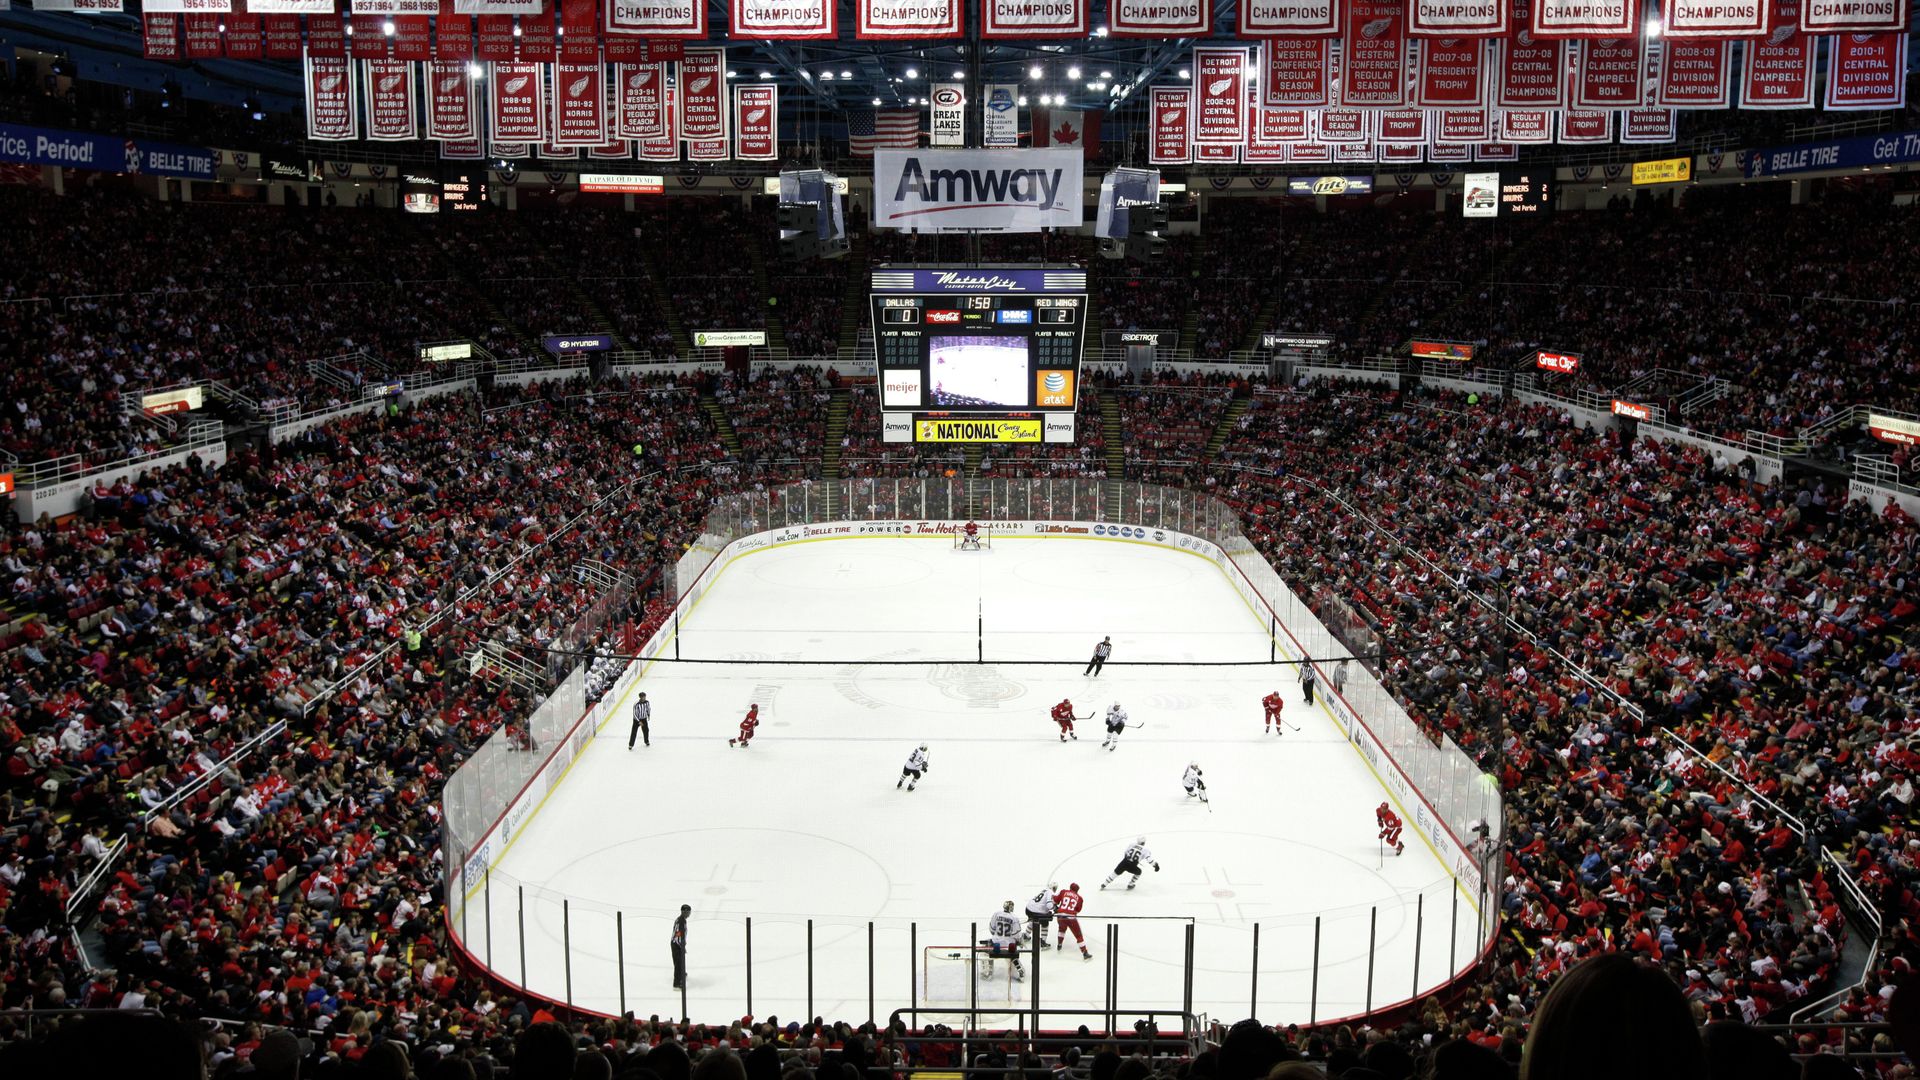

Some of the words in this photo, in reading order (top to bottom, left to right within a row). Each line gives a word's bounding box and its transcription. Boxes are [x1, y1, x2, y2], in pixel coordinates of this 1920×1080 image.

[355, 0, 393, 10] 1957-1964
[1814, 3, 1893, 16] CHAMPIONS
[616, 7, 691, 20] CHAMPIONS
[745, 8, 822, 20] CHAMPIONS
[873, 6, 948, 19] CHAMPIONS
[998, 4, 1073, 17] CHAMPIONS
[1123, 6, 1197, 18] CHAMPIONS
[1253, 7, 1328, 18] CHAMPIONS
[1353, 7, 1371, 16] RED
[1374, 7, 1401, 15] WINGS
[1420, 5, 1495, 18] CHAMPIONS
[1546, 7, 1622, 18] CHAMPIONS
[1677, 7, 1755, 19] CHAMPIONS
[1278, 41, 1317, 49] 2006-07
[1356, 41, 1395, 49] 2007-08
[1278, 51, 1317, 59] WESTERN
[1356, 51, 1395, 60] WESTERN
[1513, 50, 1552, 58] 2007-08
[1592, 49, 1633, 57] 2007-08
[1675, 48, 1715, 57] 2008-09
[1760, 47, 1800, 56] 2008-09
[1850, 47, 1884, 56] 2010-11
[1433, 54, 1472, 62] 2007-08
[1272, 61, 1322, 69] CONFERENCE
[1351, 61, 1399, 69] CONFERENCE
[1512, 63, 1552, 71] CENTRAL
[1588, 62, 1636, 70] CLARENCE
[1674, 60, 1715, 70] CENTRAL
[1755, 60, 1804, 69] CLARENCE
[1844, 59, 1888, 69] CENTRAL
[1278, 71, 1316, 80] REGULAR
[1355, 72, 1393, 80] REGULAR
[1511, 75, 1552, 84] DIVISION
[1587, 75, 1636, 83] CAMPBELL
[1672, 73, 1715, 82] DIVISION
[1754, 73, 1802, 82] CAMPBELL
[1843, 72, 1889, 82] DIVISION
[1280, 82, 1314, 90] SEASON
[1357, 82, 1391, 90] SEASON
[1435, 81, 1468, 89] TROPHY
[1764, 85, 1789, 94] BOWL
[1506, 88, 1557, 96] CHAMPIONS
[1598, 88, 1623, 96] BOWL
[1668, 85, 1719, 95] CHAMPIONS
[1838, 85, 1893, 95] CHAMPIONS
[1272, 92, 1321, 101] CHAMPIONS
[1349, 92, 1398, 101] CHAMPIONS
[1205, 98, 1235, 106] 2002-03
[934, 110, 961, 119] GREAT
[564, 119, 596, 127] DIVISION
[934, 120, 961, 129] LAKES
[685, 125, 720, 133] CHAMPIONS
[1200, 127, 1239, 135] CHAMPIONS
[561, 130, 600, 138] CHAMPIONS
[36, 136, 93, 162] Period!
[1873, 137, 1899, 160] Get
[149, 151, 185, 171] BELLE
[187, 155, 210, 173] TIRE
[1772, 151, 1812, 170] BELLE
[1812, 146, 1840, 164] TIRE
[894, 157, 1064, 210] Amway
[1503, 185, 1529, 193] RANGERS
[1542, 184, 1548, 192] 2
[1503, 194, 1524, 202] BRUINS
[886, 299, 915, 307] DALLAS
[968, 297, 991, 309] 1:58
[1055, 299, 1078, 307] WINGS
[902, 310, 911, 321] 0
[933, 311, 960, 321] Coca-Cola
[1002, 310, 1028, 319] DMC
[1057, 310, 1066, 321] 2
[571, 340, 599, 348] HYUNDAI
[1539, 353, 1558, 367] Great
[886, 382, 918, 394] meijer
[1043, 395, 1066, 405] at&t
[885, 423, 911, 432] Amway
[938, 424, 998, 439] NATIONAL
[1010, 428, 1039, 439] Island
[1047, 423, 1072, 432] Amway
[1852, 483, 1863, 492] 208
[35, 490, 47, 500] 220
[811, 527, 833, 535] BELLE
[834, 526, 851, 534] TIRE
[859, 526, 901, 534] POWER
[916, 522, 934, 534] Tim
[1044, 524, 1062, 534] Little
[1063, 525, 1088, 534] Caesars
[776, 533, 799, 542] NHL.COM
[511, 795, 532, 827] Oakwood
[1127, 848, 1142, 861] 36
[1060, 897, 1078, 911] 93
[996, 921, 1011, 937] 32
